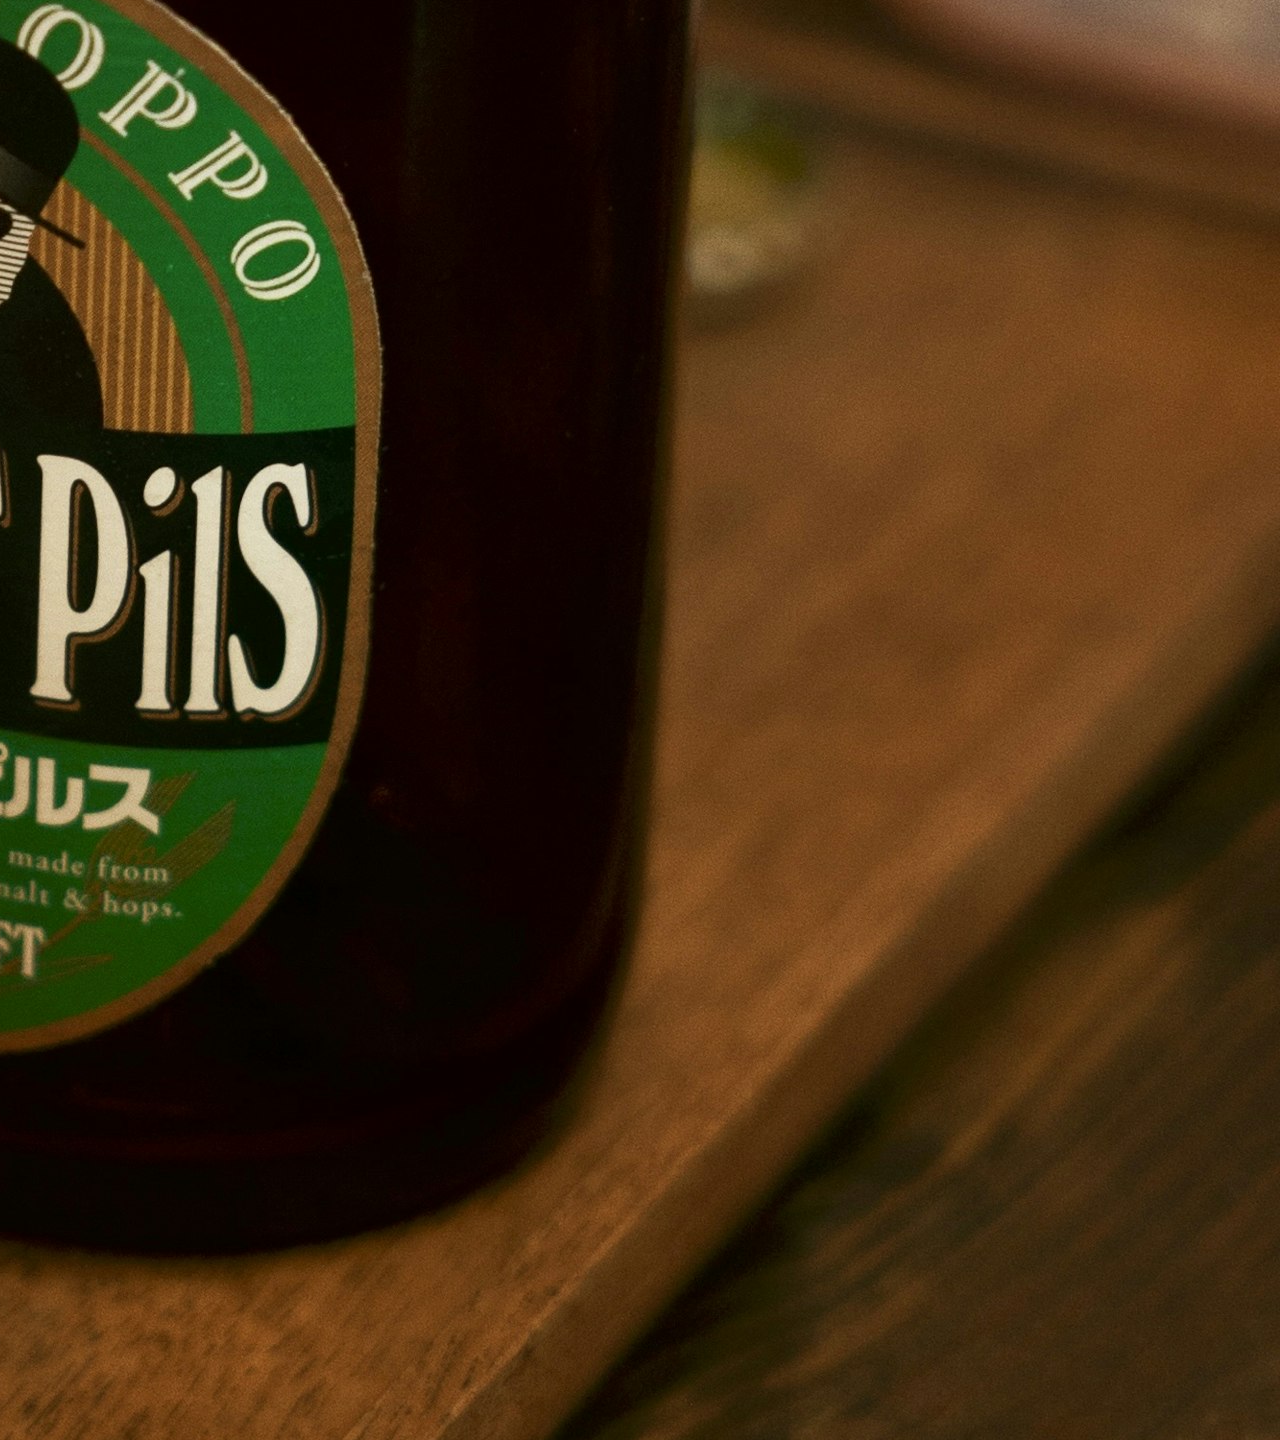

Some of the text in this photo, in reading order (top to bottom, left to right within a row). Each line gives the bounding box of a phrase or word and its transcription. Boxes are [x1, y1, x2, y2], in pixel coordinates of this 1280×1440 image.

[8, 849, 85, 877] made
[97, 854, 174, 884] from
[62, 887, 90, 913] &
[102, 889, 185, 926] hops.
